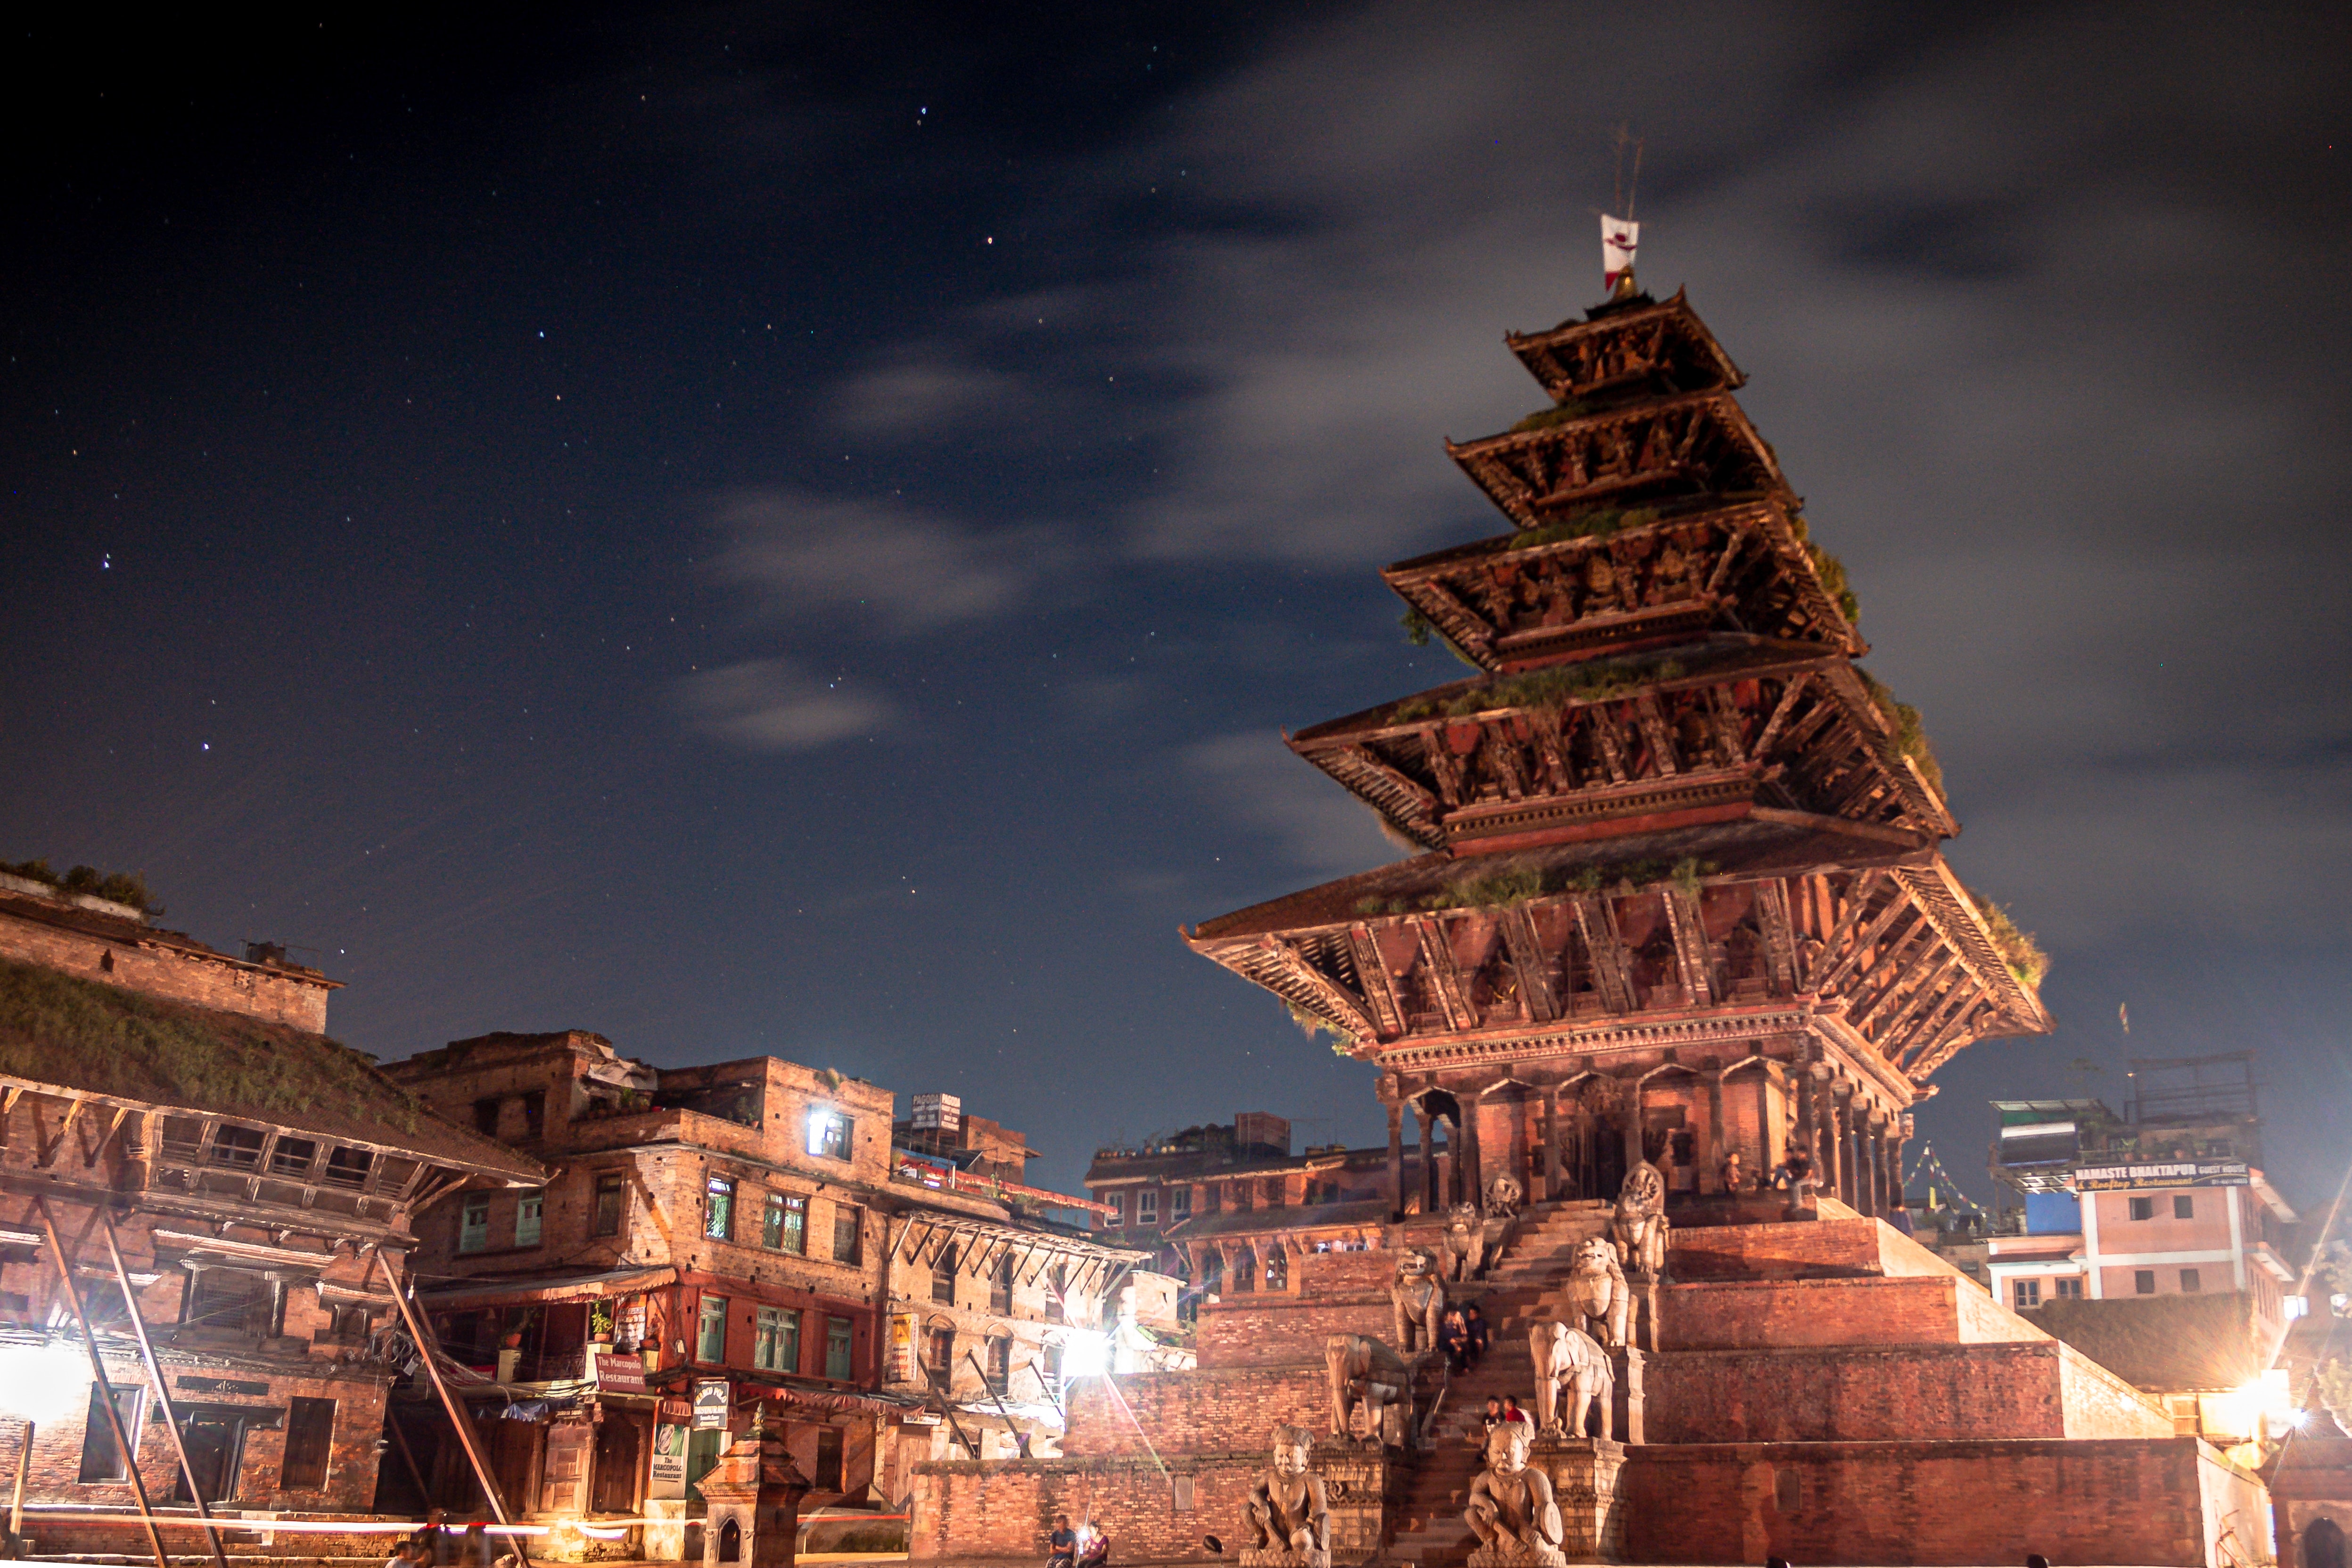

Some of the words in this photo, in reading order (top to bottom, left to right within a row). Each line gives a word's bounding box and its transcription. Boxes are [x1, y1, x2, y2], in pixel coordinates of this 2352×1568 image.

[913, 1093, 939, 1105] PAGODA
[941, 1093, 961, 1108] PAGODA
[2075, 1166, 2128, 1180] NAMASTE
[2129, 1164, 2196, 1177] BHAKTAPUR
[2089, 1178, 2130, 1190] Rooftop
[2134, 1177, 2193, 1188] Restaurant
[597, 1356, 609, 1366] The
[610, 1357, 641, 1370] Marcopolo
[599, 1370, 643, 1384] Restaurant
[695, 1386, 713, 1405] MARCO
[713, 1387, 727, 1403] POLO
[694, 1405, 727, 1414] RESTAURANT
[653, 1470, 682, 1478] Restaurant
